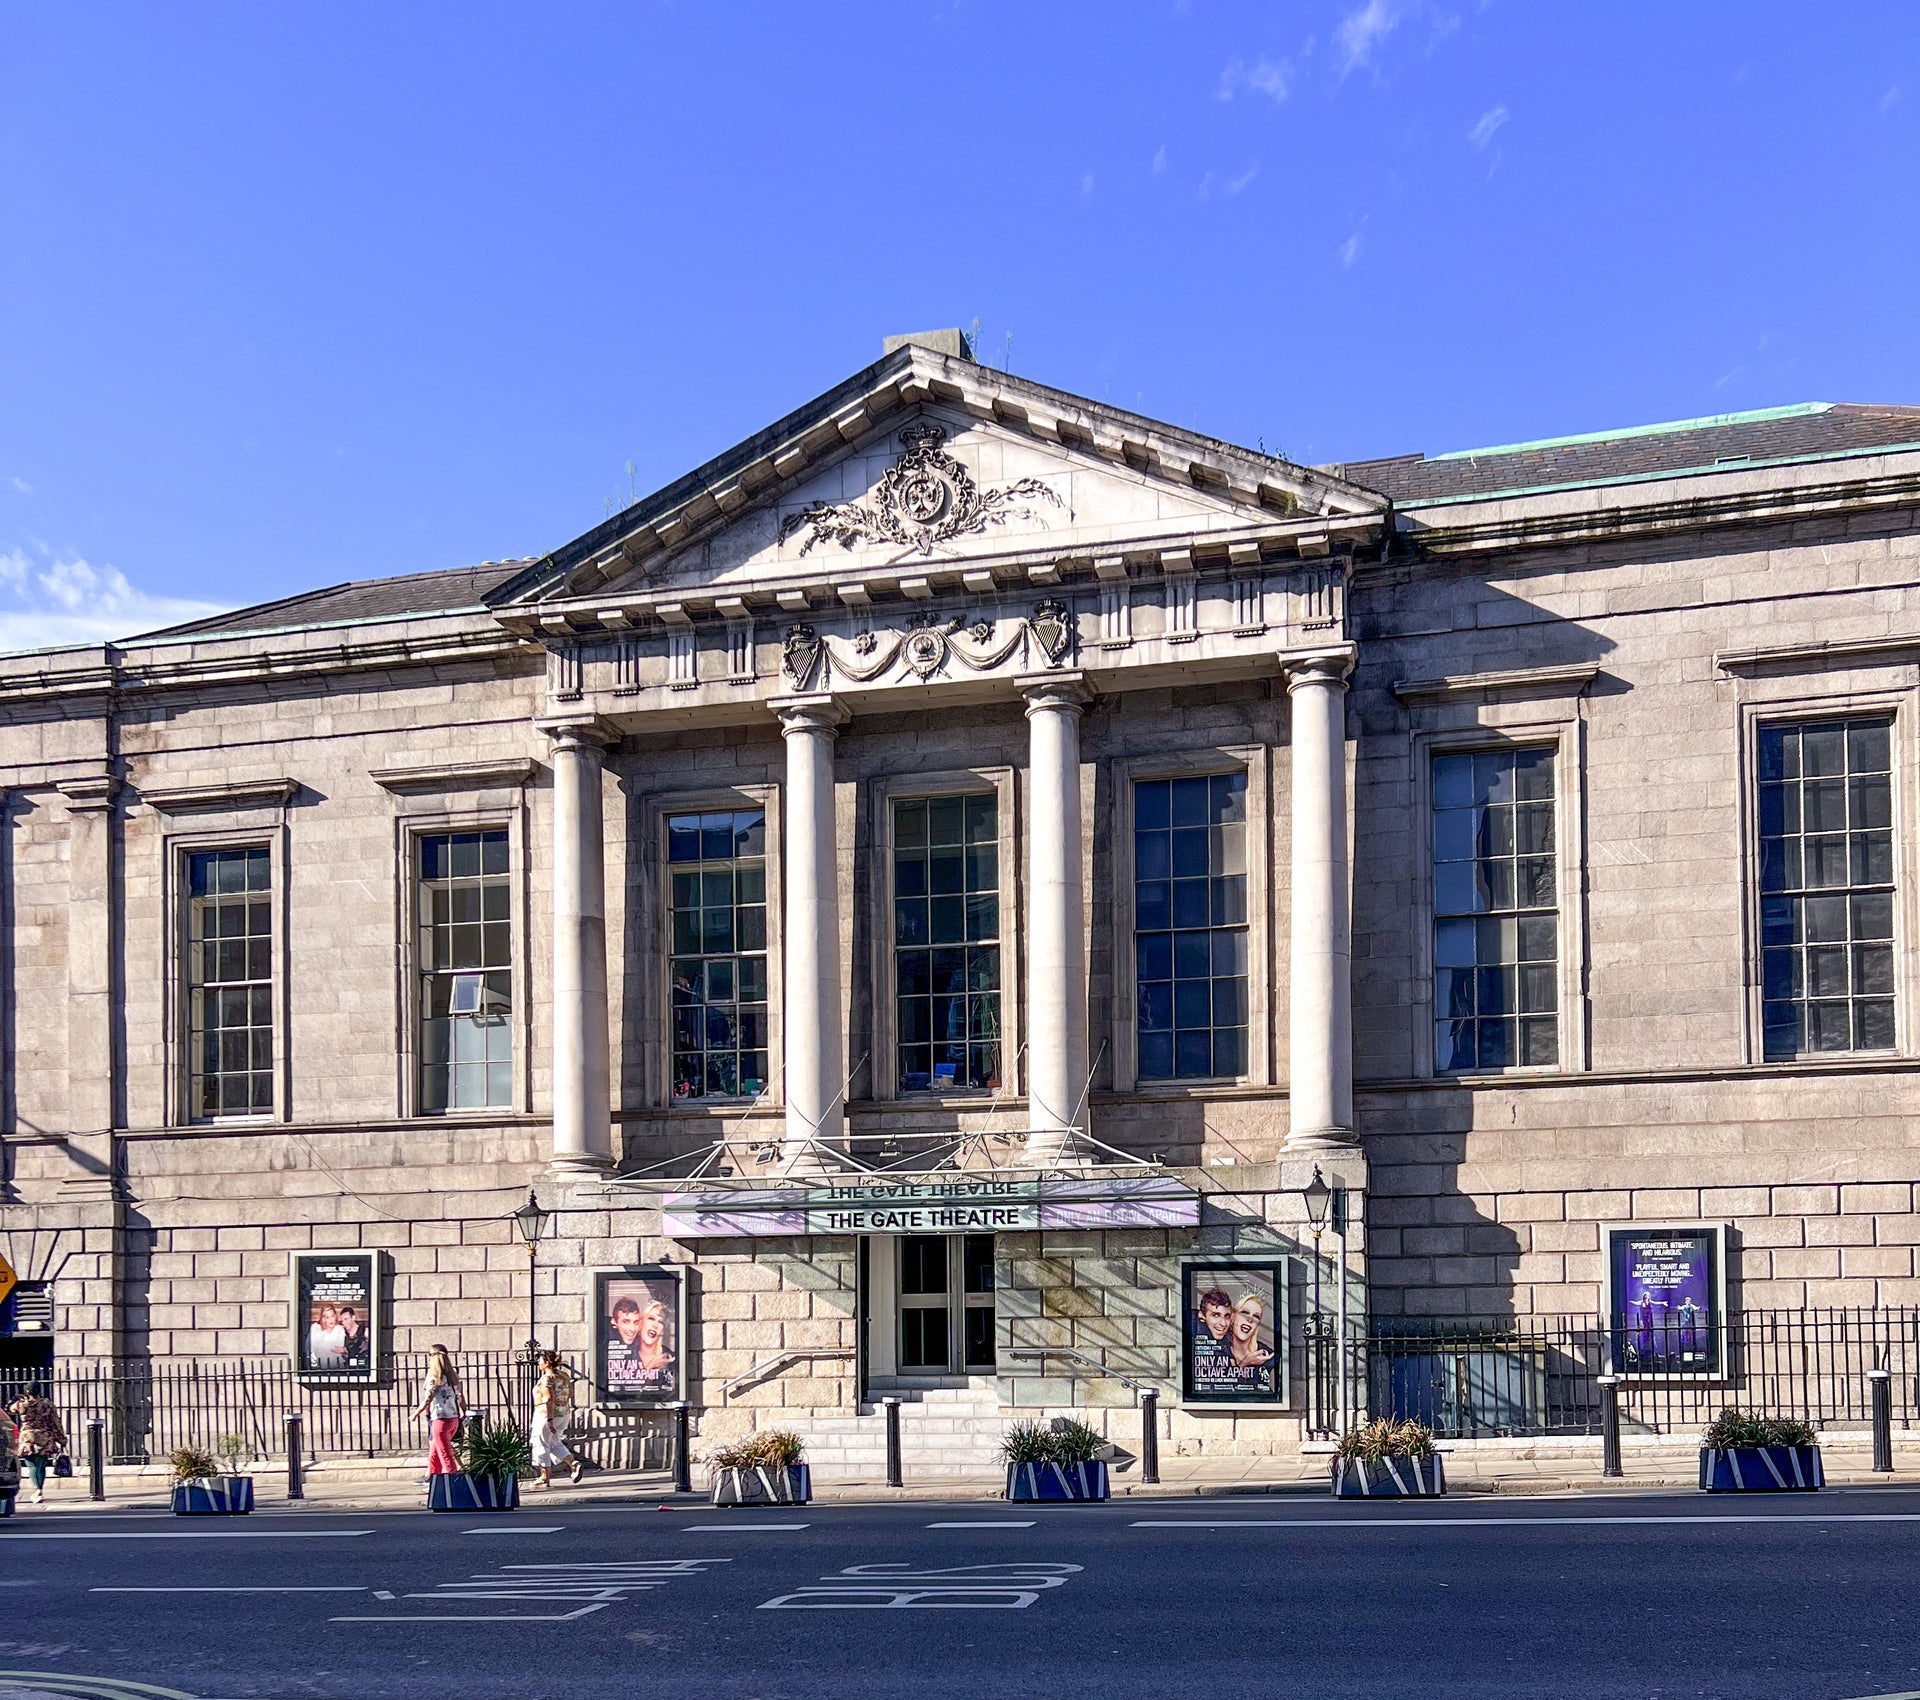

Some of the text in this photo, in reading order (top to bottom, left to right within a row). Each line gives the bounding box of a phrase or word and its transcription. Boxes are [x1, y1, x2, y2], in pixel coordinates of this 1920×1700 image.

[827, 1209, 1019, 1228] THE GATE THEATRE
[1086, 1210, 1100, 1223] AN
[1148, 1207, 1182, 1221] APART
[608, 1360, 638, 1370] ONLY AN
[1195, 1356, 1229, 1367] ONLY AN
[608, 1369, 660, 1380] OCTAVE APART
[1195, 1366, 1255, 1378] OCTAVE APART
[756, 1562, 1084, 1609] BUS
